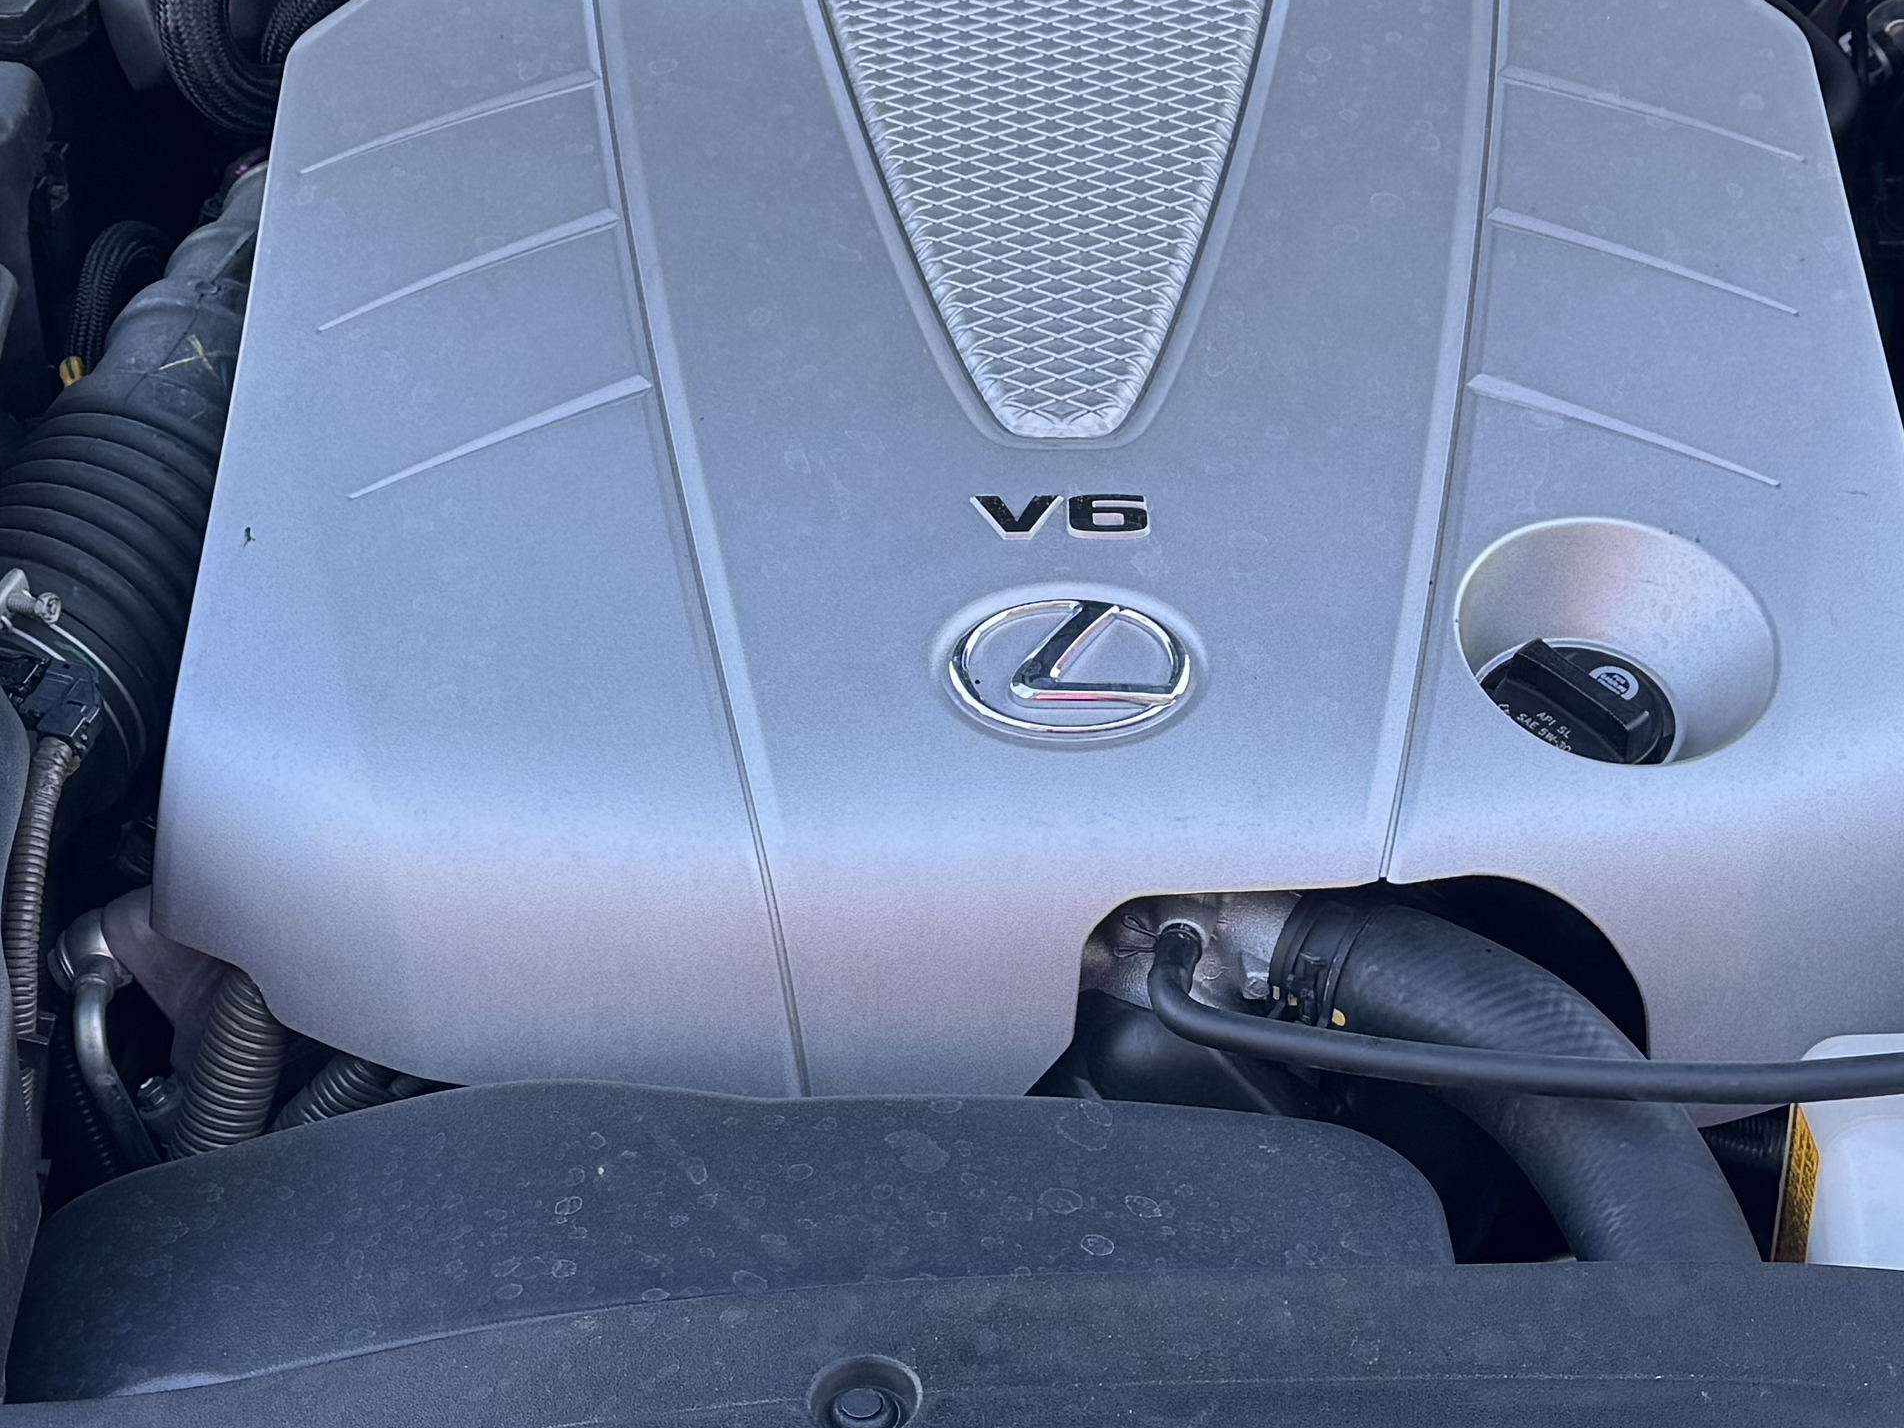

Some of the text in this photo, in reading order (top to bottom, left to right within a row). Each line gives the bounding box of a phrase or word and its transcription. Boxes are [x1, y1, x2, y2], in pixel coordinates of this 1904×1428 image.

[968, 493, 1152, 541] V6
[1516, 712, 1540, 730] SAE
[1535, 711, 1572, 740] API SL
